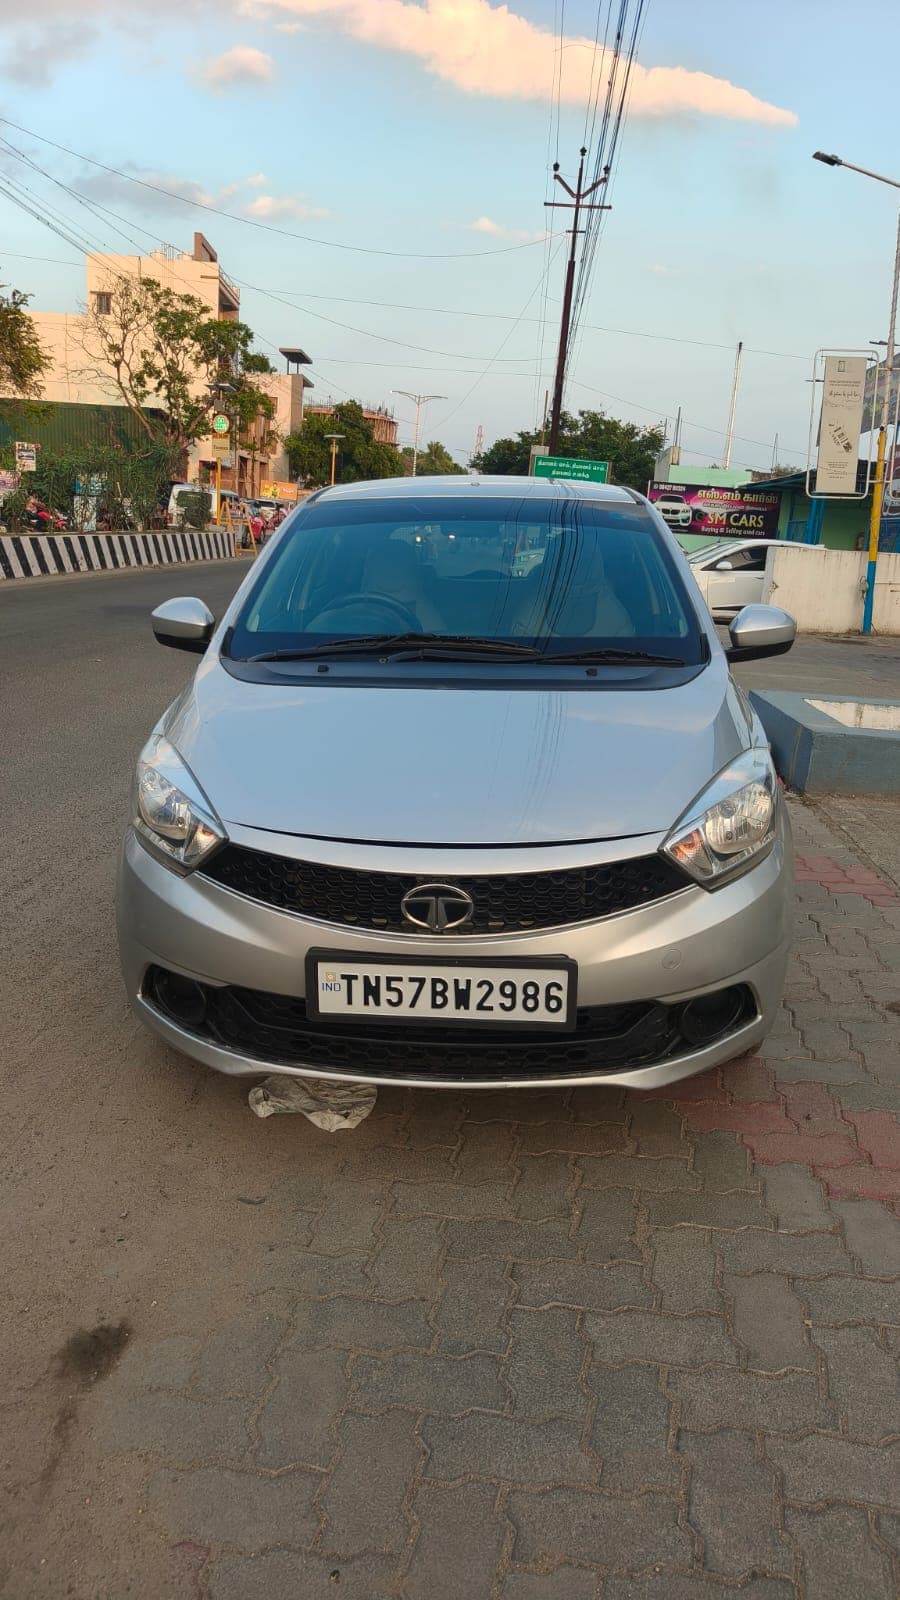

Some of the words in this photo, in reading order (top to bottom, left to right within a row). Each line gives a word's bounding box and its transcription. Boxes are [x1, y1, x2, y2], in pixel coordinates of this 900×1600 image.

[707, 511, 728, 525] SM
[729, 513, 765, 528] CARS
[321, 982, 341, 992] IND
[340, 973, 564, 1014] TN57BW2986
